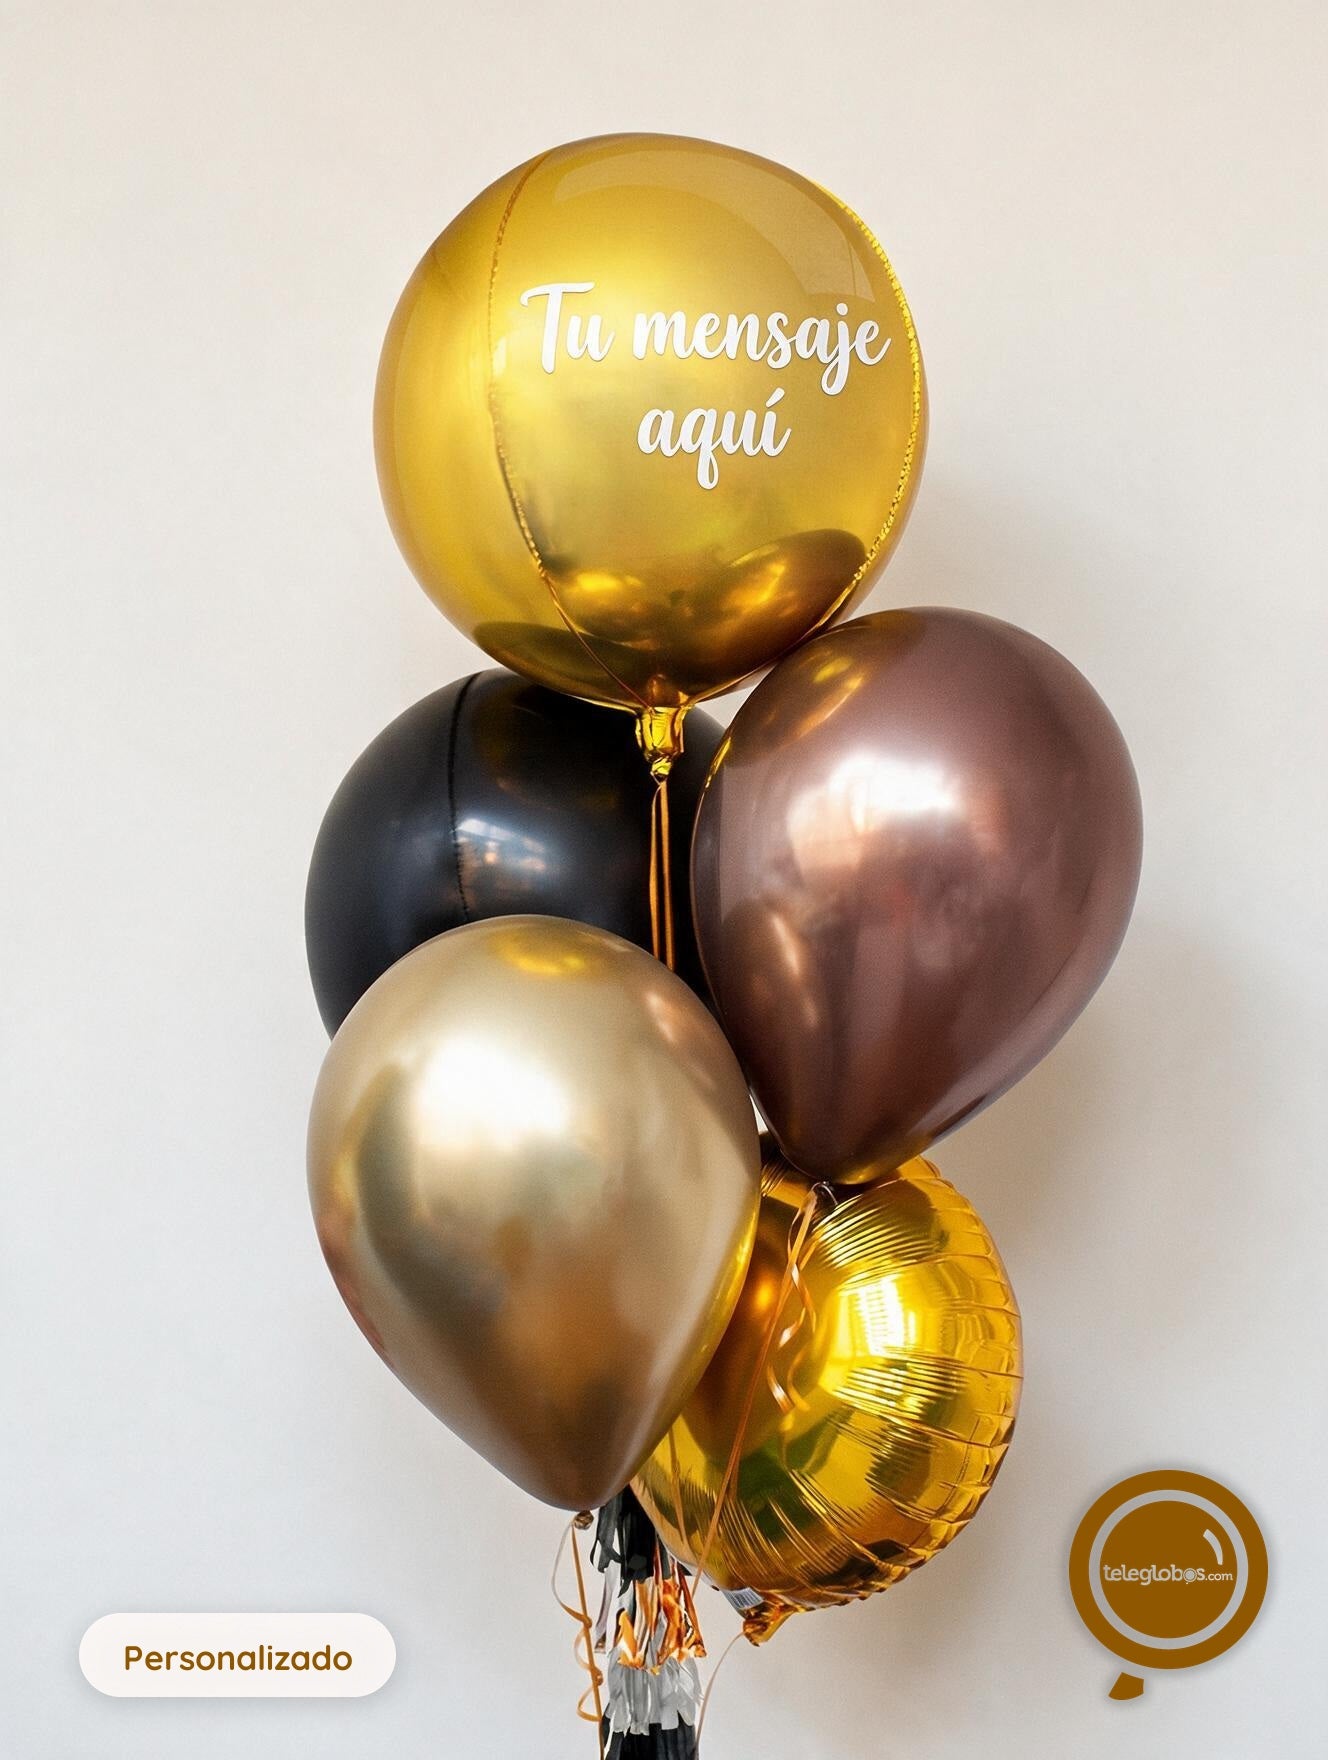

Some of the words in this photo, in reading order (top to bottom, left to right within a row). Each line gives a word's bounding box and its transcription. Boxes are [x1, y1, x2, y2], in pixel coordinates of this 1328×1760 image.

[520, 281, 615, 374] Tu
[632, 302, 891, 396] mensaje
[637, 387, 792, 490] aquí
